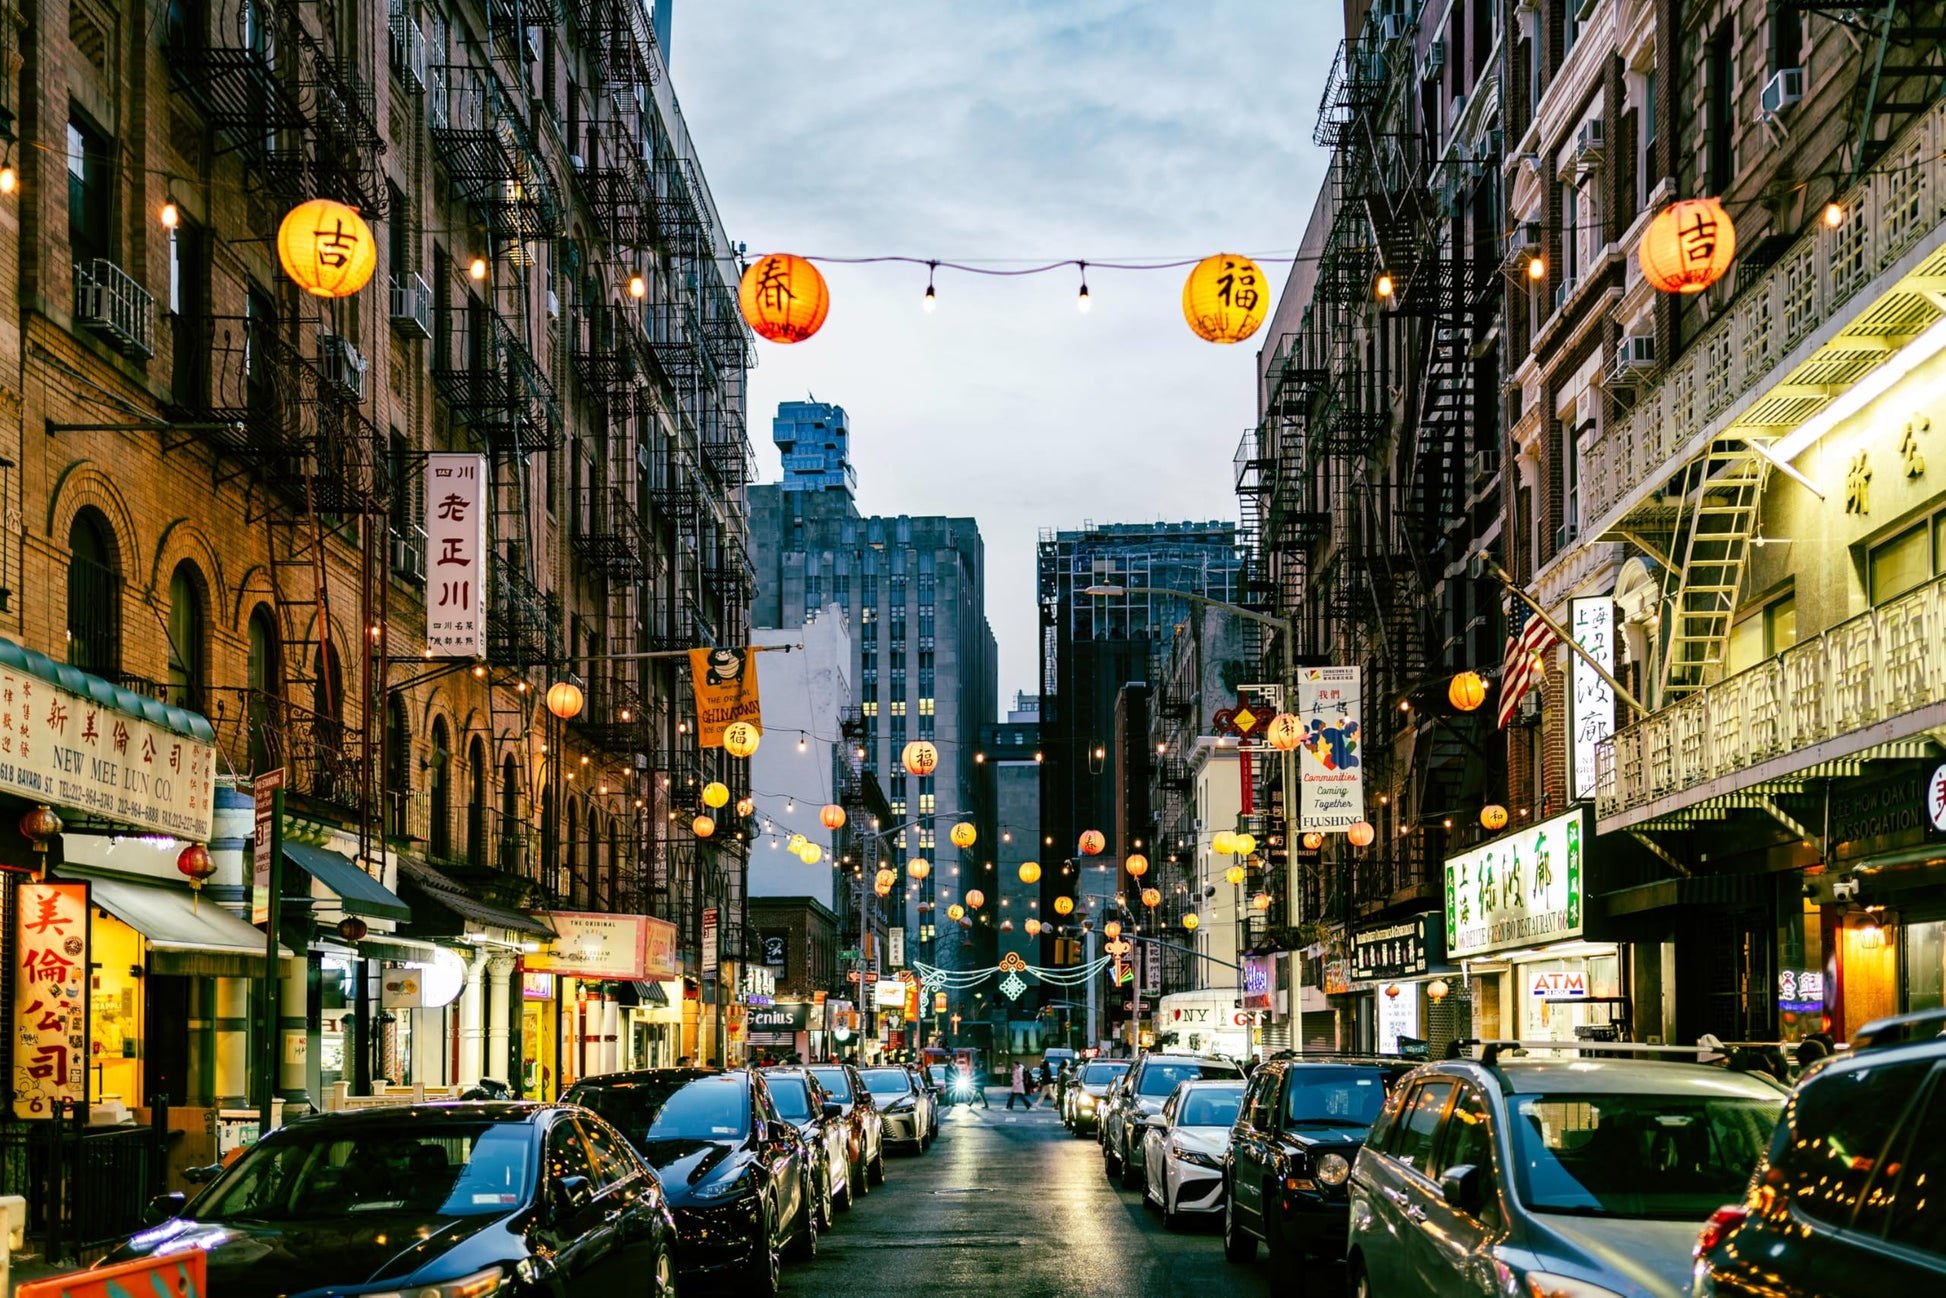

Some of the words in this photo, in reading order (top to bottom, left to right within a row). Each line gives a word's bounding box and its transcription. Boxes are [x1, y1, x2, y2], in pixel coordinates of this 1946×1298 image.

[313, 218, 358, 268] 吉
[1679, 213, 1718, 262] 吉
[1217, 262, 1258, 311] 福
[435, 466, 474, 480] 四川
[437, 492, 471, 611] 老正川
[707, 697, 720, 705] THE
[723, 689, 751, 703] ORIGAL
[47, 697, 183, 775] 新美倫公司
[730, 726, 746, 744] 福
[916, 748, 934, 767] 福
[17, 768, 42, 791] BAYARD
[53, 745, 84, 775] NEW
[90, 757, 118, 787] MEE
[124, 767, 150, 795] LUN
[1303, 772, 1358, 783] Communities
[1317, 786, 1349, 798] Coming
[1855, 792, 1878, 814] HOW
[1882, 783, 1906, 807] OAK
[1314, 799, 1353, 811] Together
[1303, 816, 1361, 827] FLUSHING
[257, 826, 263, 846] 3
[1507, 921, 1516, 941] BO
[1516, 911, 1557, 940] RESTAURANT
[22, 890, 75, 1088] 美倫公司
[1534, 974, 1584, 989] ATM
[746, 1011, 794, 1024] Genius
[1183, 1008, 1210, 1022] NY
